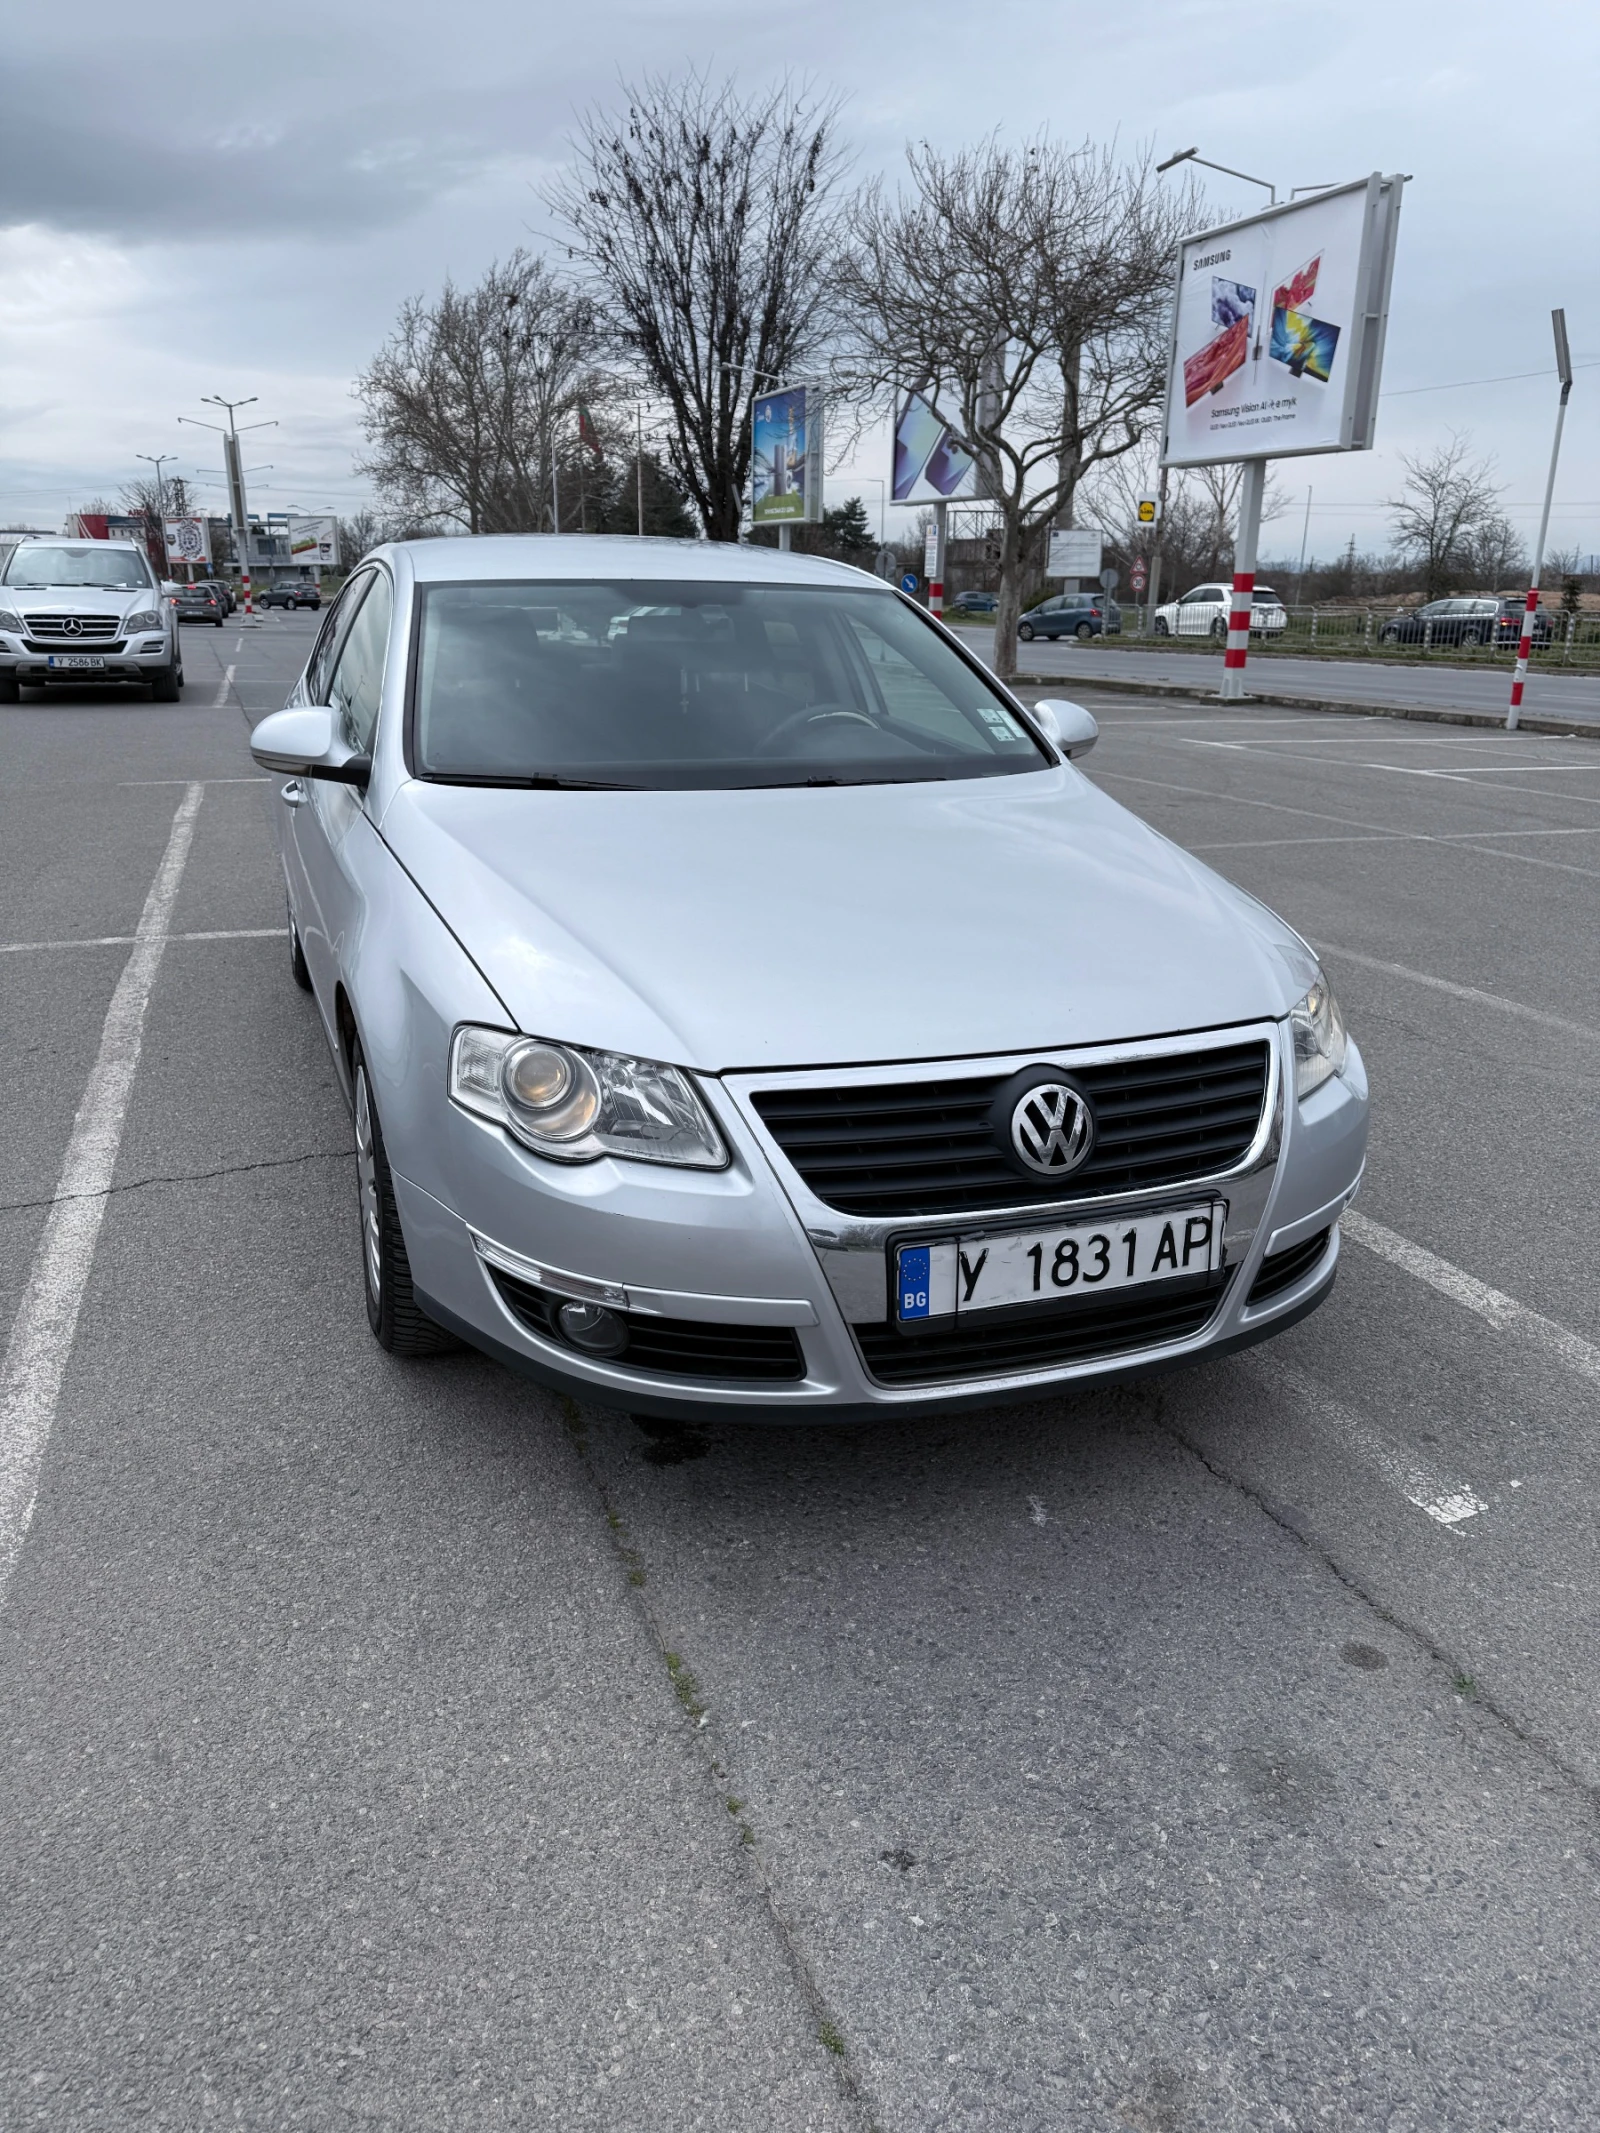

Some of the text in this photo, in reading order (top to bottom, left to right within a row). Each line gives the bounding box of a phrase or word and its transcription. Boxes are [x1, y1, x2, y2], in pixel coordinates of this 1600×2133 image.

[1193, 249, 1231, 271] SAMSUNG
[1211, 406, 1240, 418] Samsung
[1241, 402, 1260, 413] Vision
[68, 657, 90, 667] 2586
[1027, 1227, 1137, 1292] 1831
[1150, 1215, 1212, 1272] AP
[904, 1291, 927, 1309] BG
